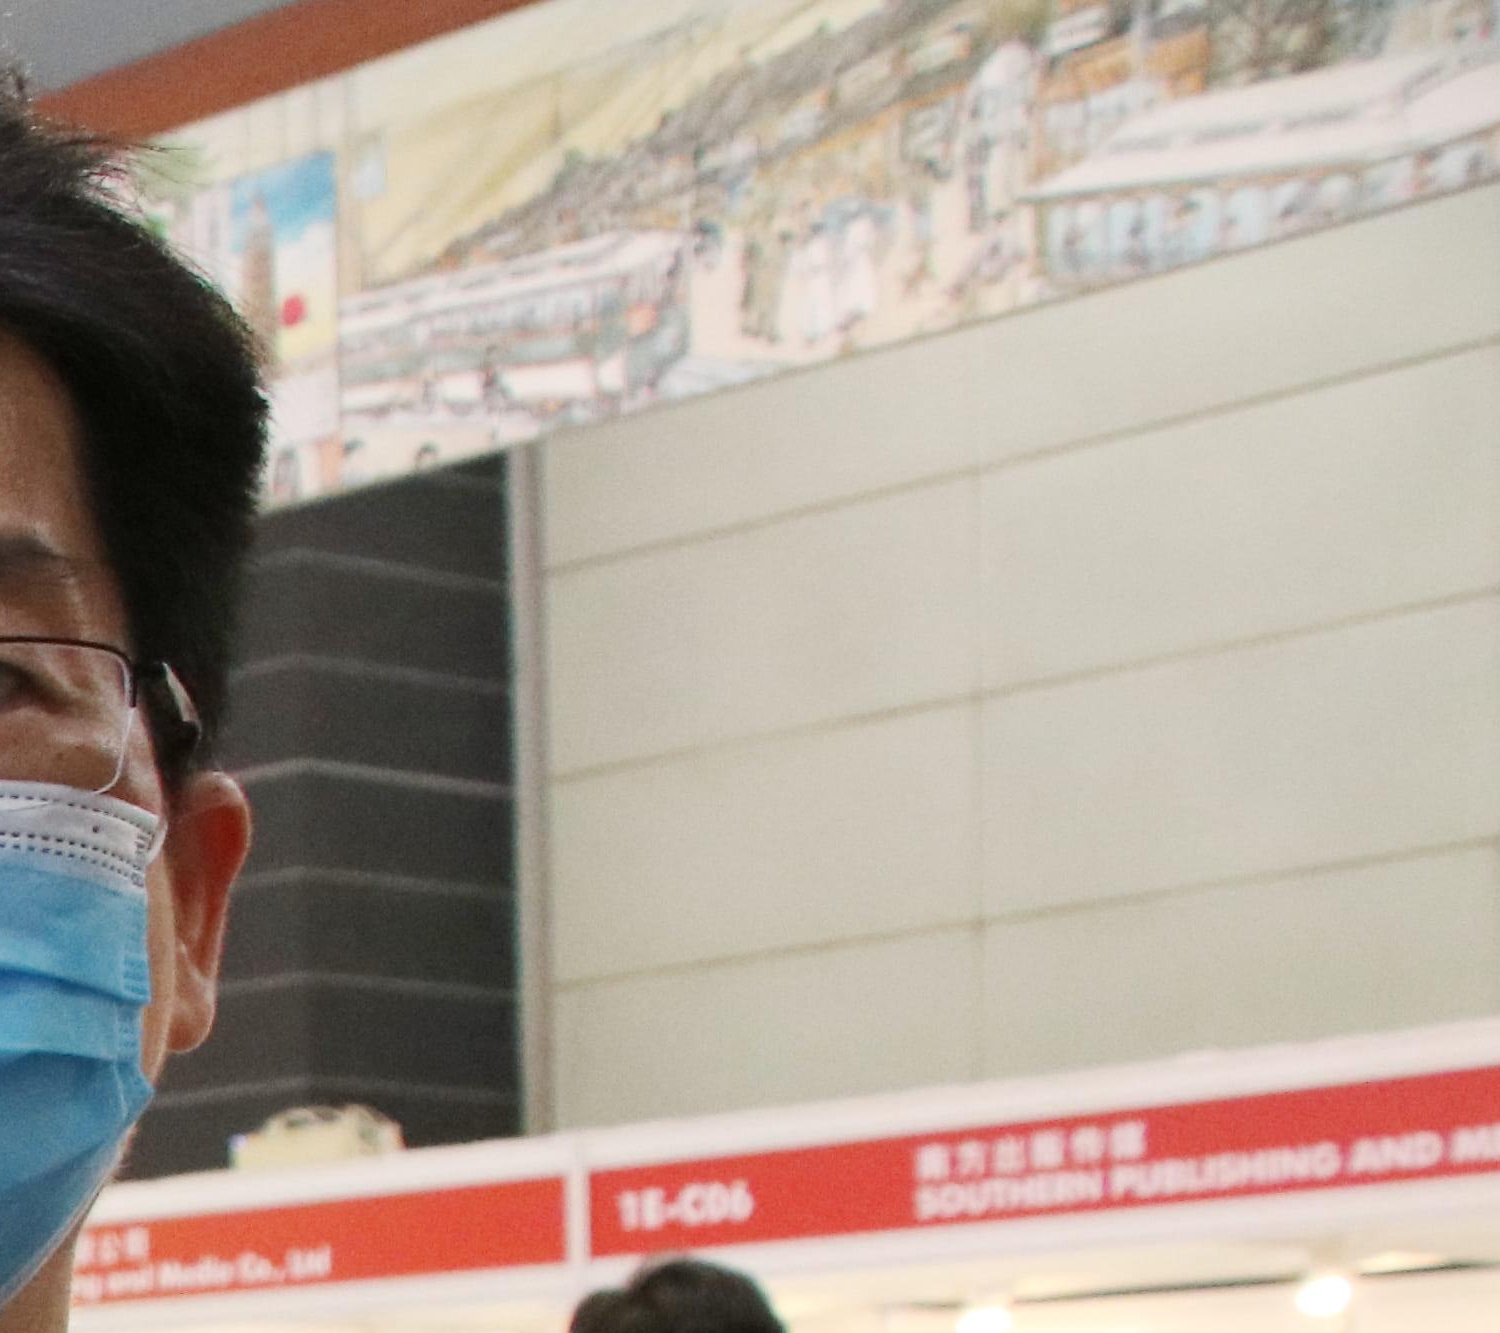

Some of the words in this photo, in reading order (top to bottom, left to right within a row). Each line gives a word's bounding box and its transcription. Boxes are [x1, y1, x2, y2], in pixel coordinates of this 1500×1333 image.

[914, 1170, 1101, 1223] SOUTHERN
[1110, 1142, 1340, 1199] PUBLISHING
[1348, 1130, 1444, 1176] AND
